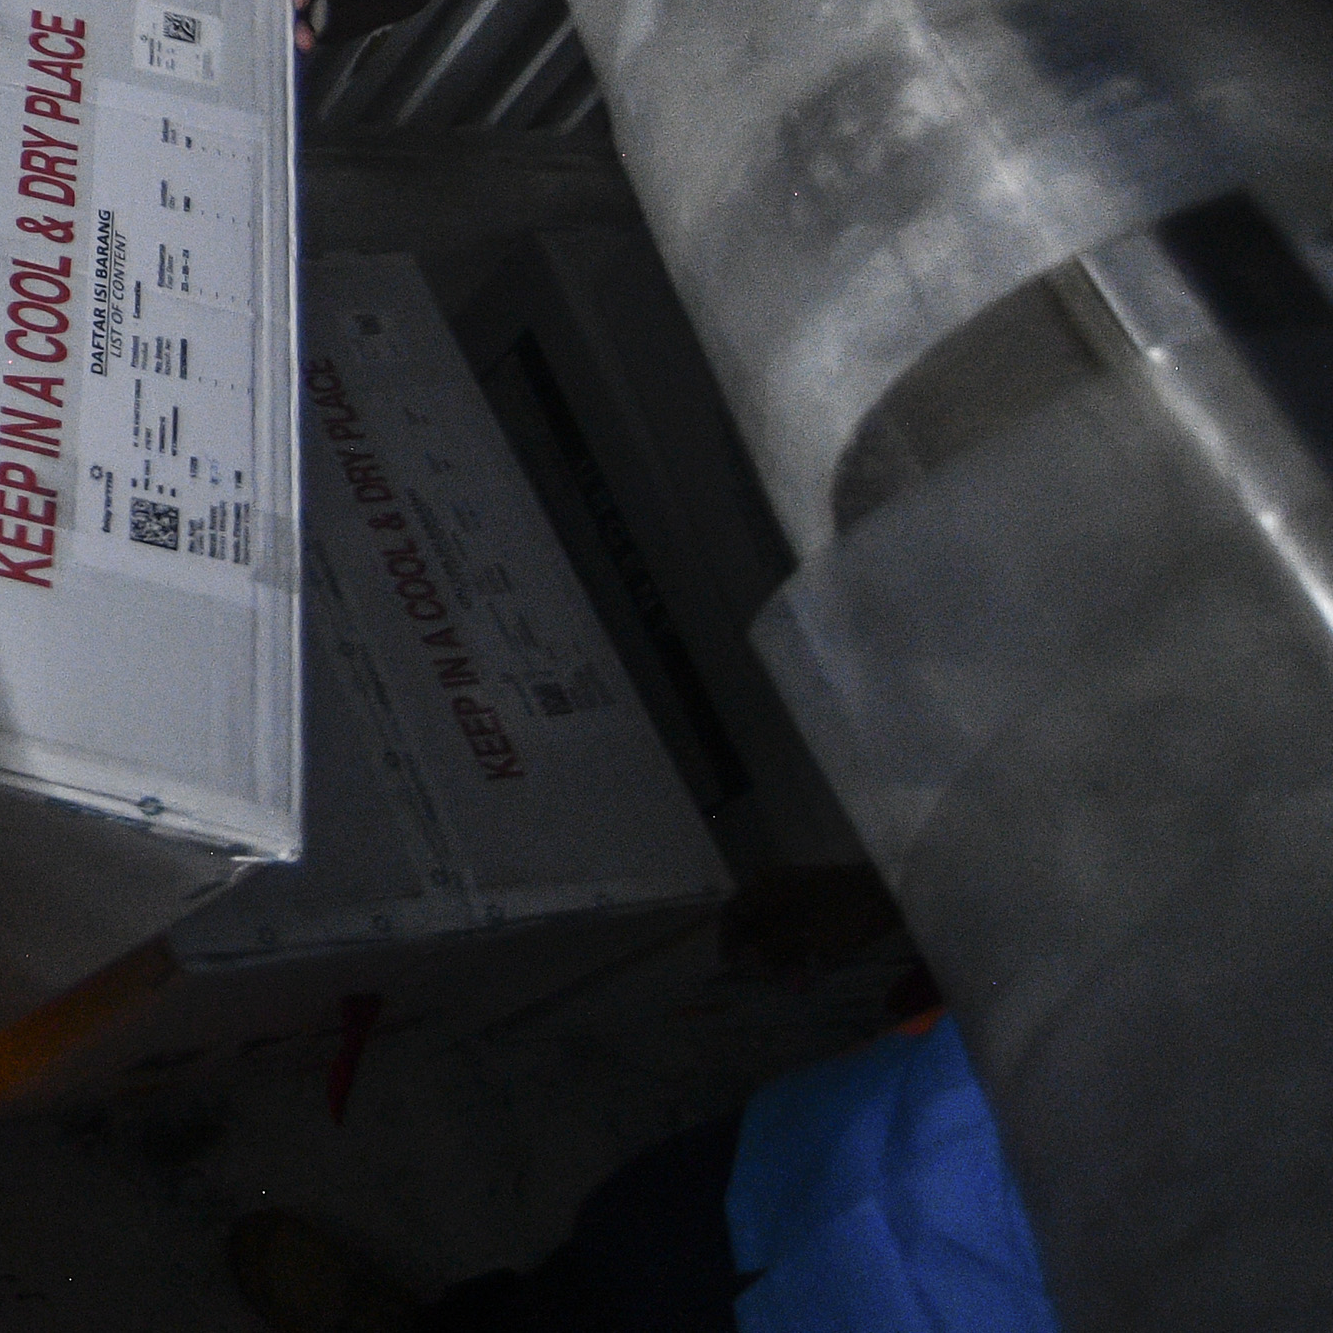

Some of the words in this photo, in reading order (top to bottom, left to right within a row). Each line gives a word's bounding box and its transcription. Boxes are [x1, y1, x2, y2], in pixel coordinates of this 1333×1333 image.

[24, 10, 86, 125] PLACE
[17, 125, 79, 207] DRY
[16, 216, 75, 245] &
[96, 209, 111, 279] BARANG
[94, 283, 107, 303] ISI
[112, 230, 127, 301] CONTENT
[4, 257, 73, 363] COOL
[90, 307, 106, 375] DAFTAR
[110, 327, 123, 358] LIST
[111, 303, 123, 325] OF
[2, 374, 65, 408] A
[304, 357, 366, 442] PLACE
[337, 449, 393, 503] DRY
[382, 538, 446, 622] COOL
[423, 628, 462, 649] A
[433, 656, 480, 689] IN
[453, 696, 525, 782] KEEP
